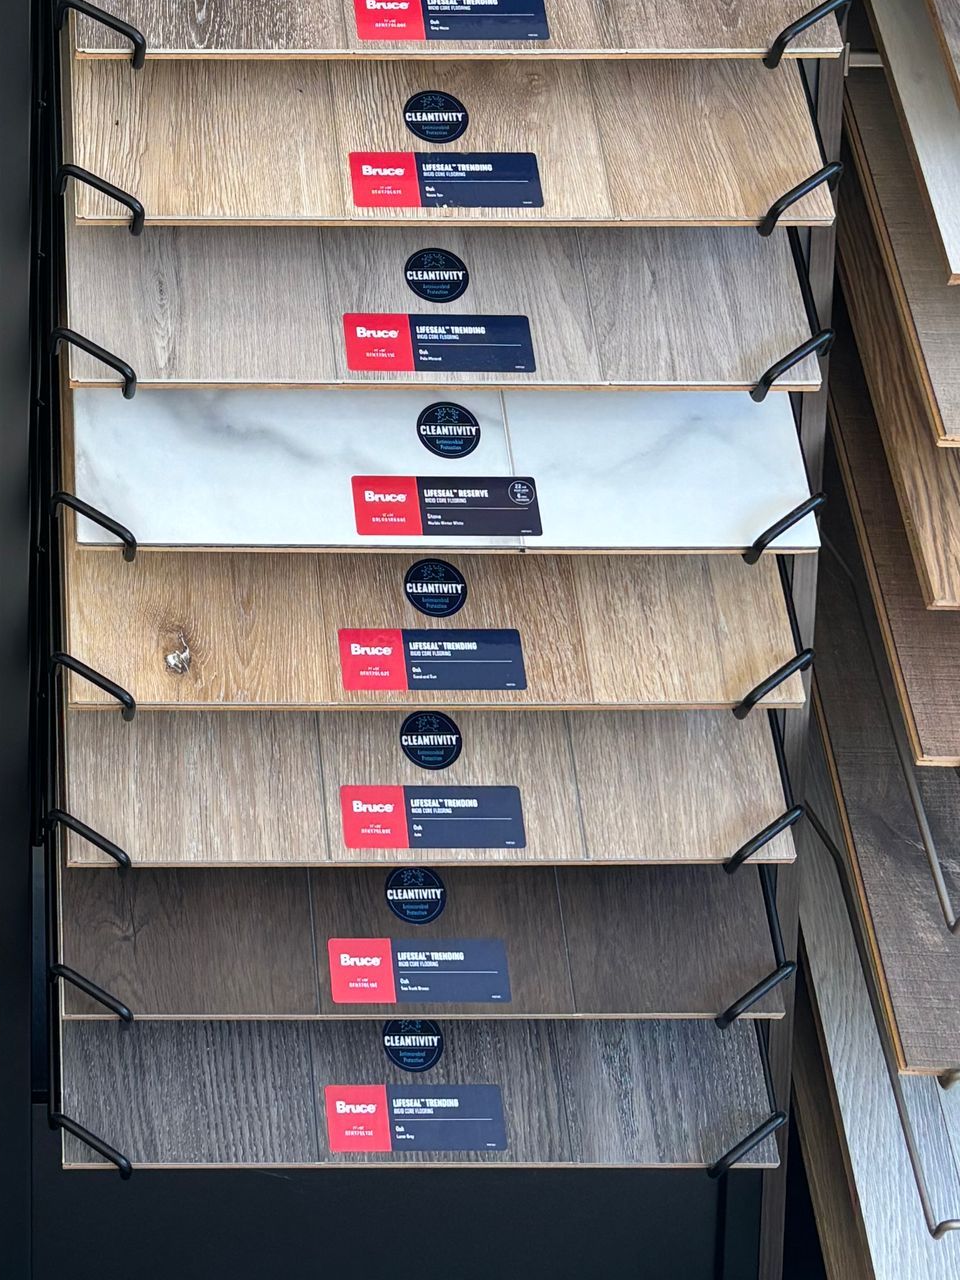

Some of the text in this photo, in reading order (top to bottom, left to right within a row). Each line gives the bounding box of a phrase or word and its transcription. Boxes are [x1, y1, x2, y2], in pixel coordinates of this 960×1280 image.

[366, 0, 409, 9] Bruce
[362, 165, 405, 176] Bruce
[356, 327, 399, 338] Bruce
[451, 326, 485, 334] TRENDING
[365, 491, 407, 502] Bruce
[351, 644, 392, 656] Bruce
[352, 801, 394, 813] Bruce
[340, 954, 381, 966] Bruce
[336, 1101, 376, 1114] Bruce
